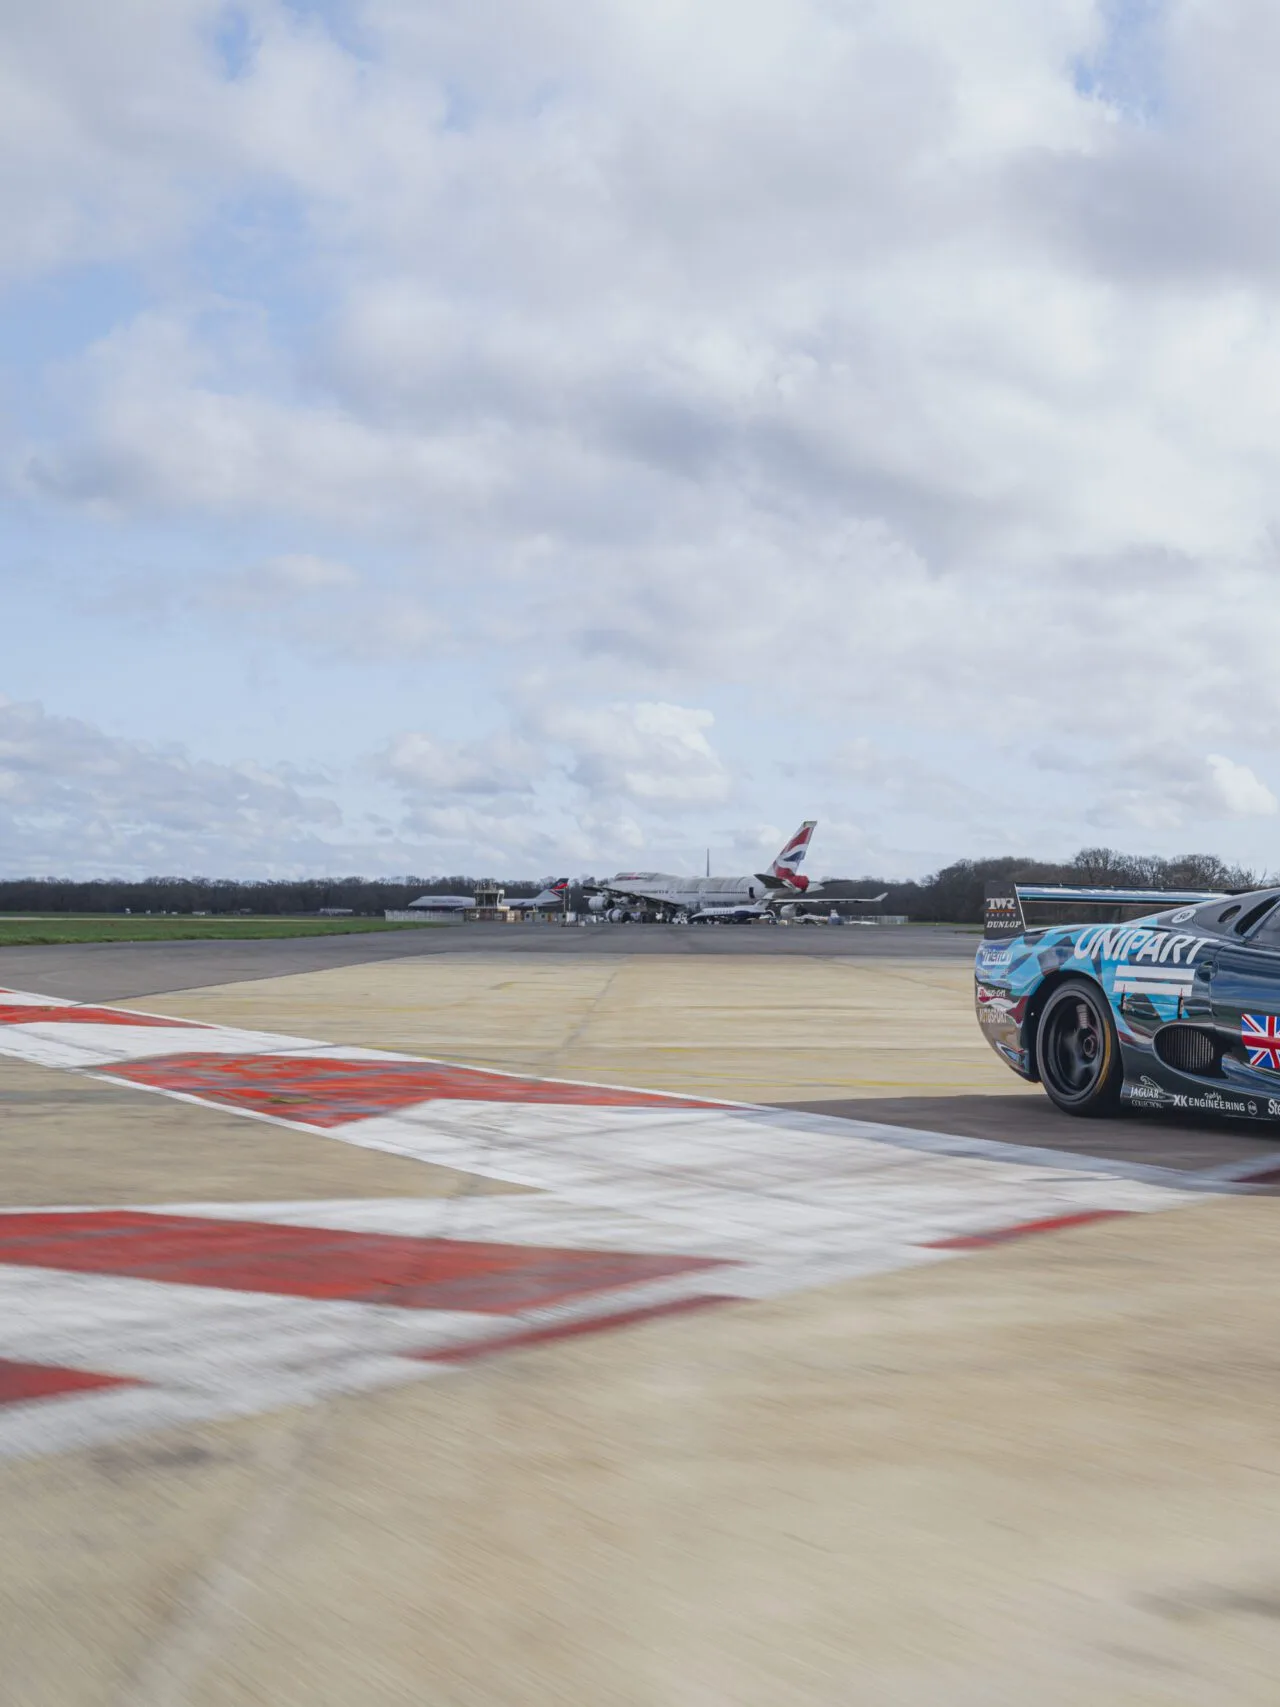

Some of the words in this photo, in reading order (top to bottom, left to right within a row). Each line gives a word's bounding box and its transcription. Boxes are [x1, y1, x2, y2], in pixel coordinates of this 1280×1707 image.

[986, 898, 1016, 910] TWR
[1074, 927, 1219, 965] UNIPART
[1129, 1086, 1159, 1099] JAGUAR
[1173, 1094, 1189, 1107] XK
[1188, 1098, 1246, 1112] ENGINEERING
